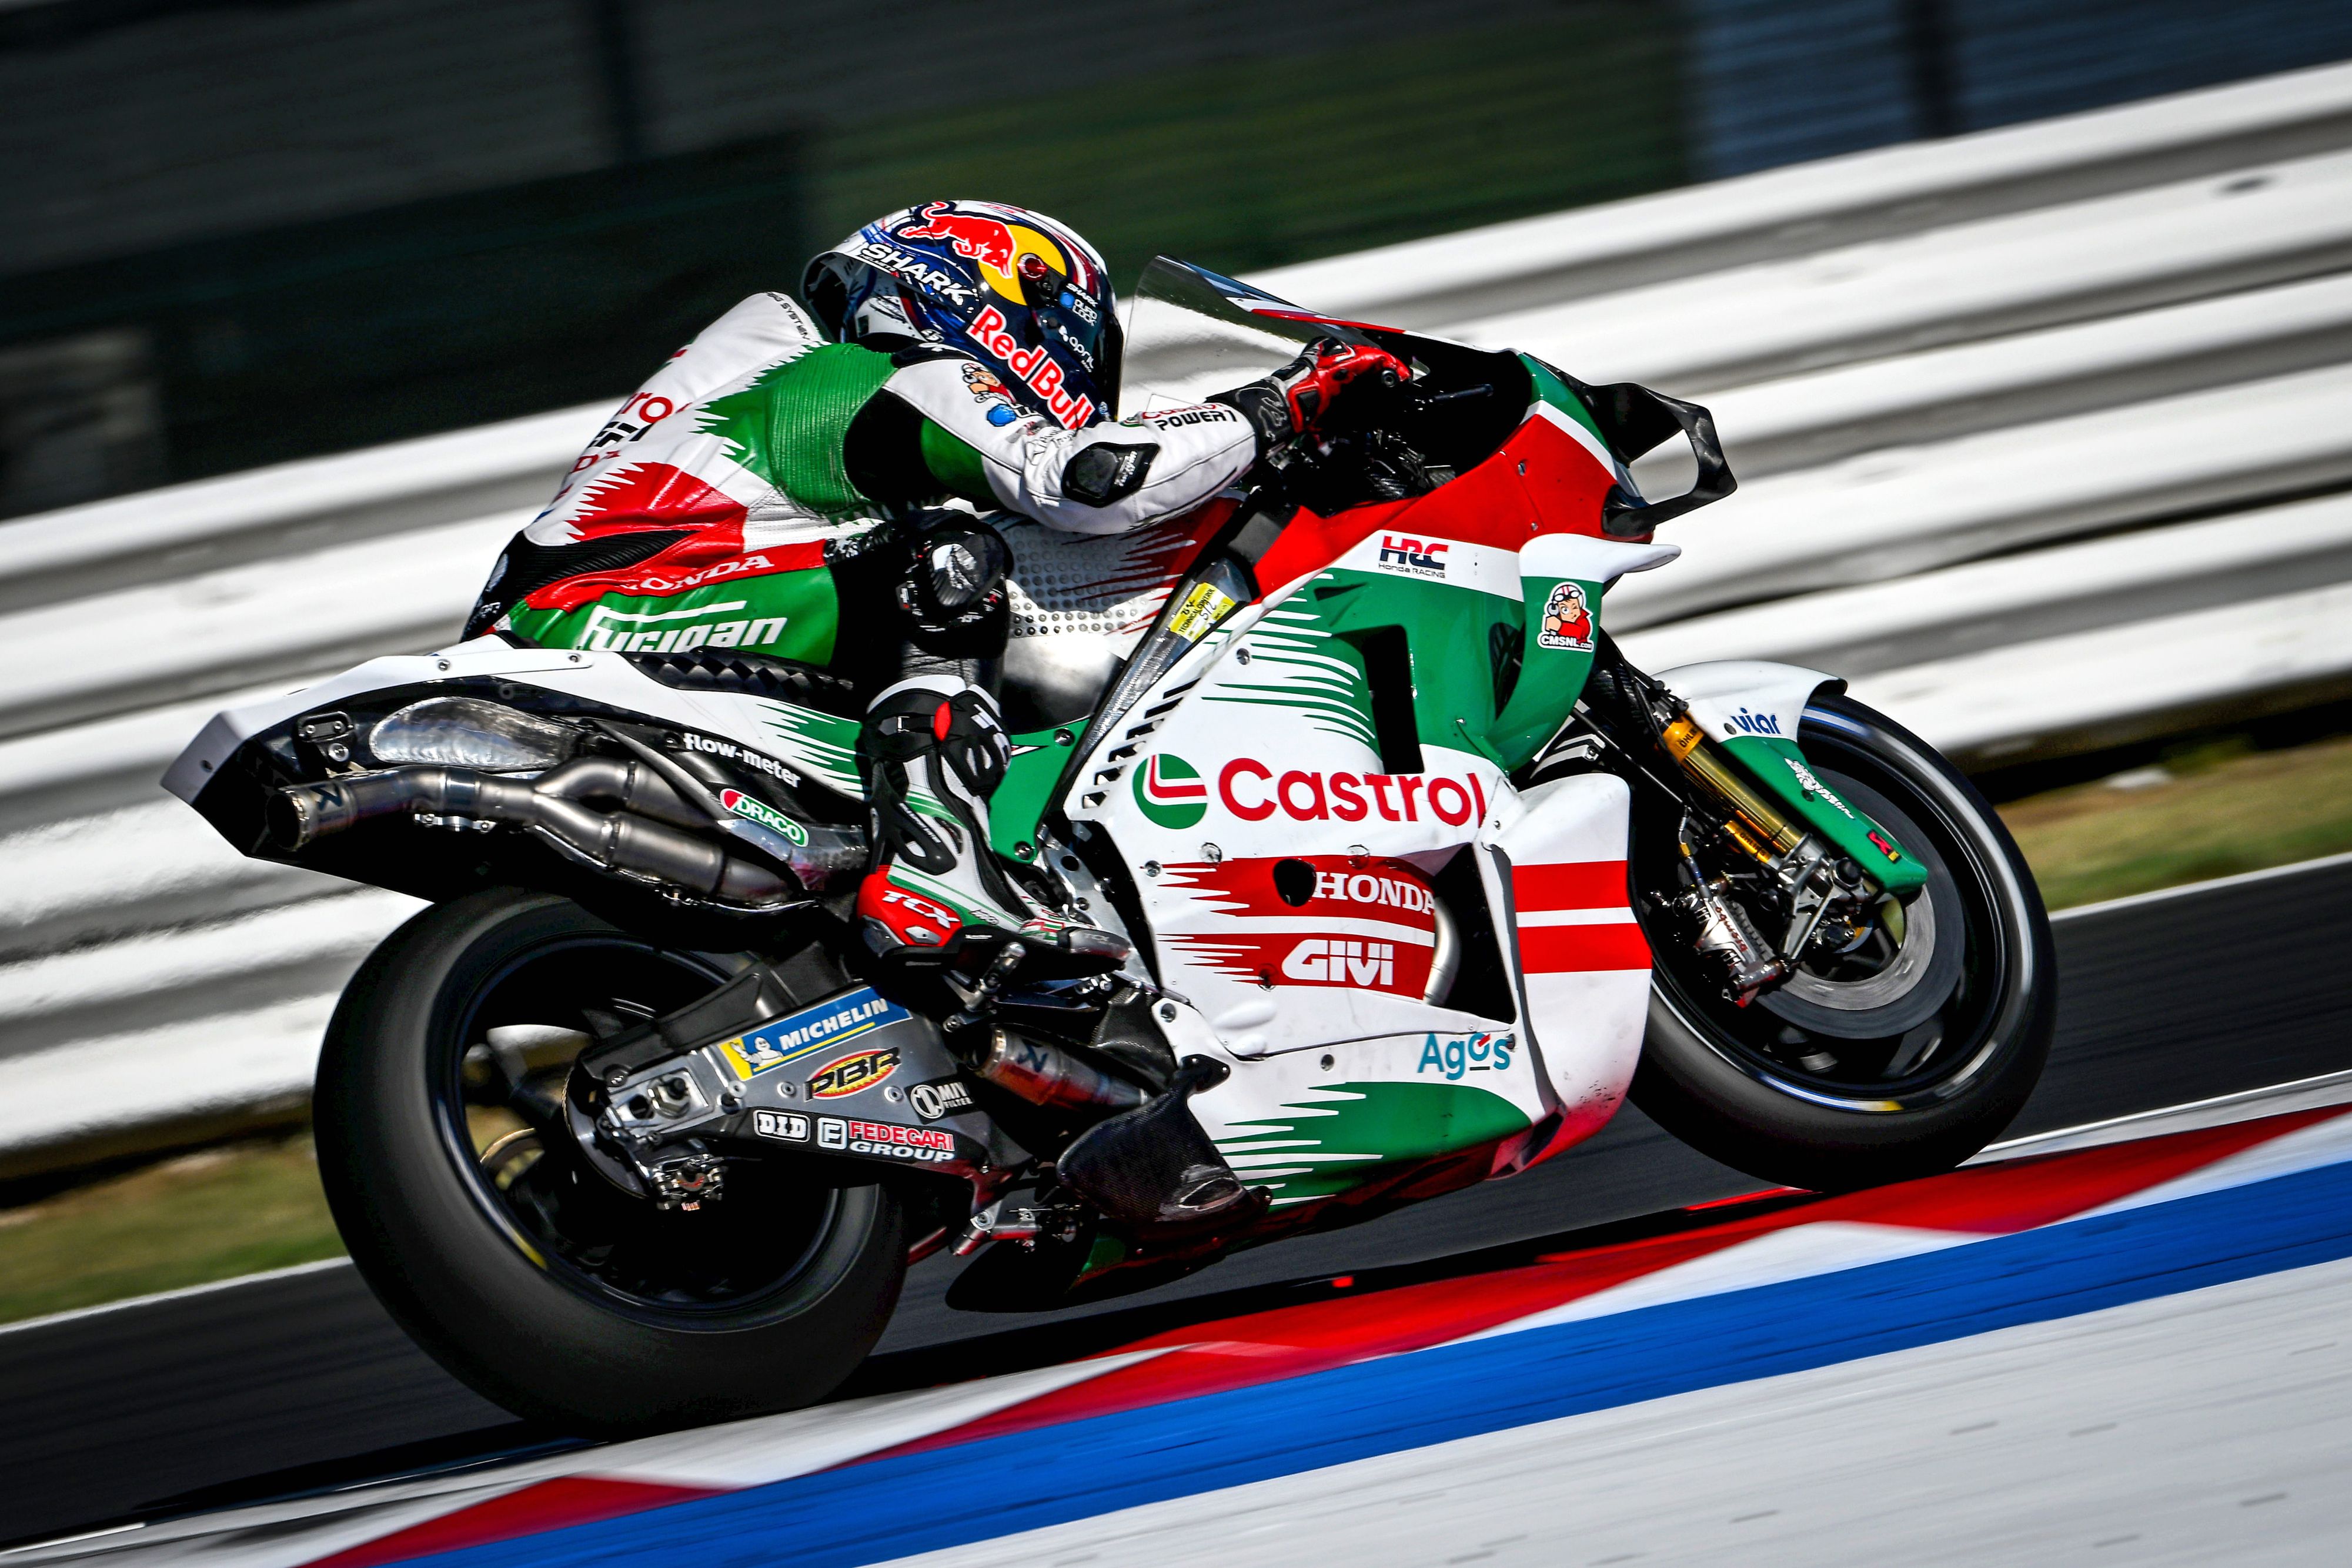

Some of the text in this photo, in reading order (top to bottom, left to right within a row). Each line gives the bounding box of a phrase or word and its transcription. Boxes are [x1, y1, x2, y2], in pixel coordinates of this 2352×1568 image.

[861, 244, 976, 306] SHARK
[1066, 283, 1098, 307] SHARK
[1072, 305, 1097, 326] LOCK
[1074, 299, 1097, 319] QUAD
[966, 305, 1095, 430] Red Bull
[1378, 563, 1445, 578] Honda RACING
[1379, 536, 1449, 570] HRC
[1178, 607, 1201, 633] TECHNICAL
[1196, 589, 1215, 610] CONTROL
[683, 733, 801, 788] flow-meter
[1219, 758, 1486, 828] Castrol
[733, 796, 801, 841] DRACO
[883, 890, 960, 928] TCX
[1312, 871, 1435, 915] HONDA
[1281, 940, 1393, 986] GIVI
[779, 998, 888, 1051] MICHELIN
[804, 1047, 901, 1101] PBR
[848, 1120, 956, 1152] FEDEGARI
[849, 1141, 956, 1163] GROUP
